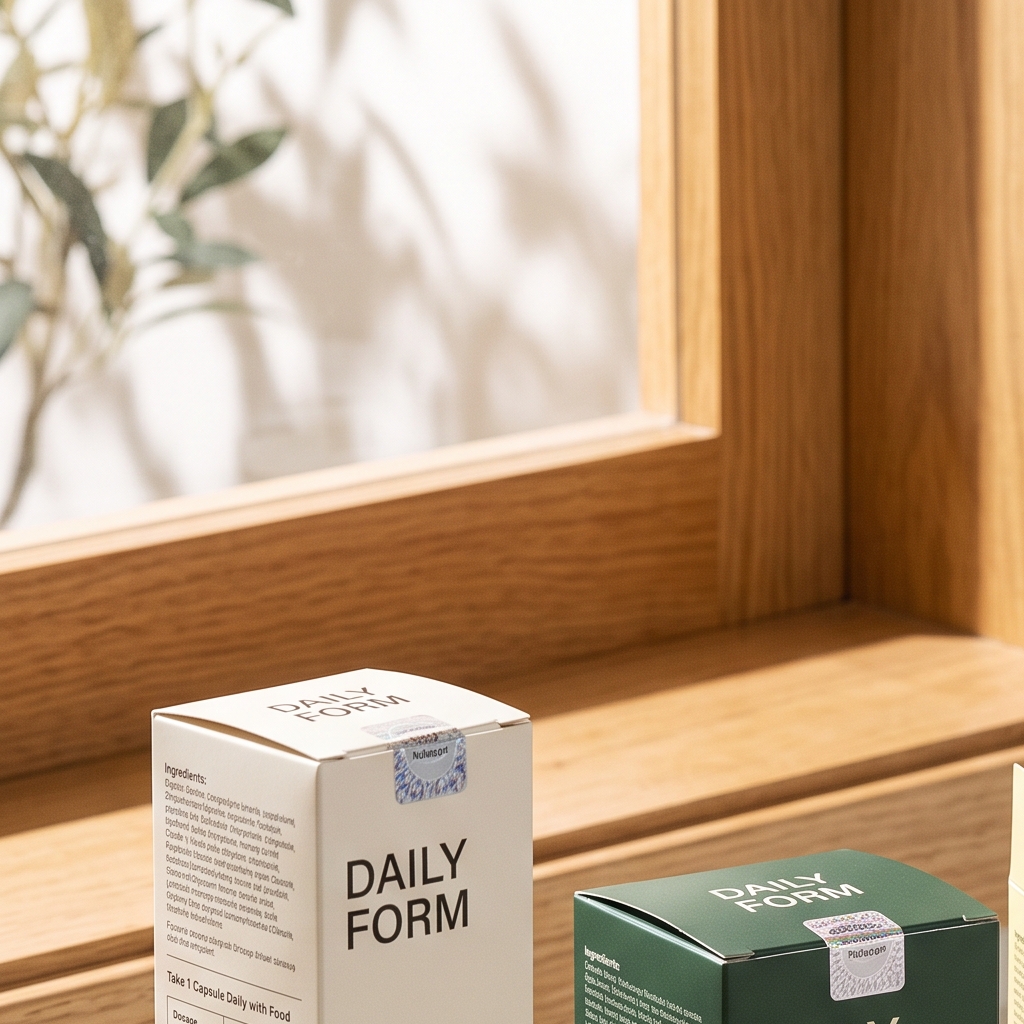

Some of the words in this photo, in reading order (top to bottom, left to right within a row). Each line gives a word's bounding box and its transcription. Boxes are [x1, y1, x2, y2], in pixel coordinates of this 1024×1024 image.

[268, 686, 375, 713] DAILY
[293, 695, 411, 722] FORM
[164, 762, 207, 785] Ingredients:
[347, 838, 467, 900] DAILY
[708, 873, 827, 900] DAILY
[734, 884, 864, 912] FORM
[347, 888, 468, 950] FORM
[167, 970, 185, 987] Take
[187, 978, 191, 989] 1
[193, 981, 225, 1001] Capsule
[226, 992, 247, 1011] Daily
[249, 1001, 267, 1015] with
[269, 1006, 291, 1022] Food
